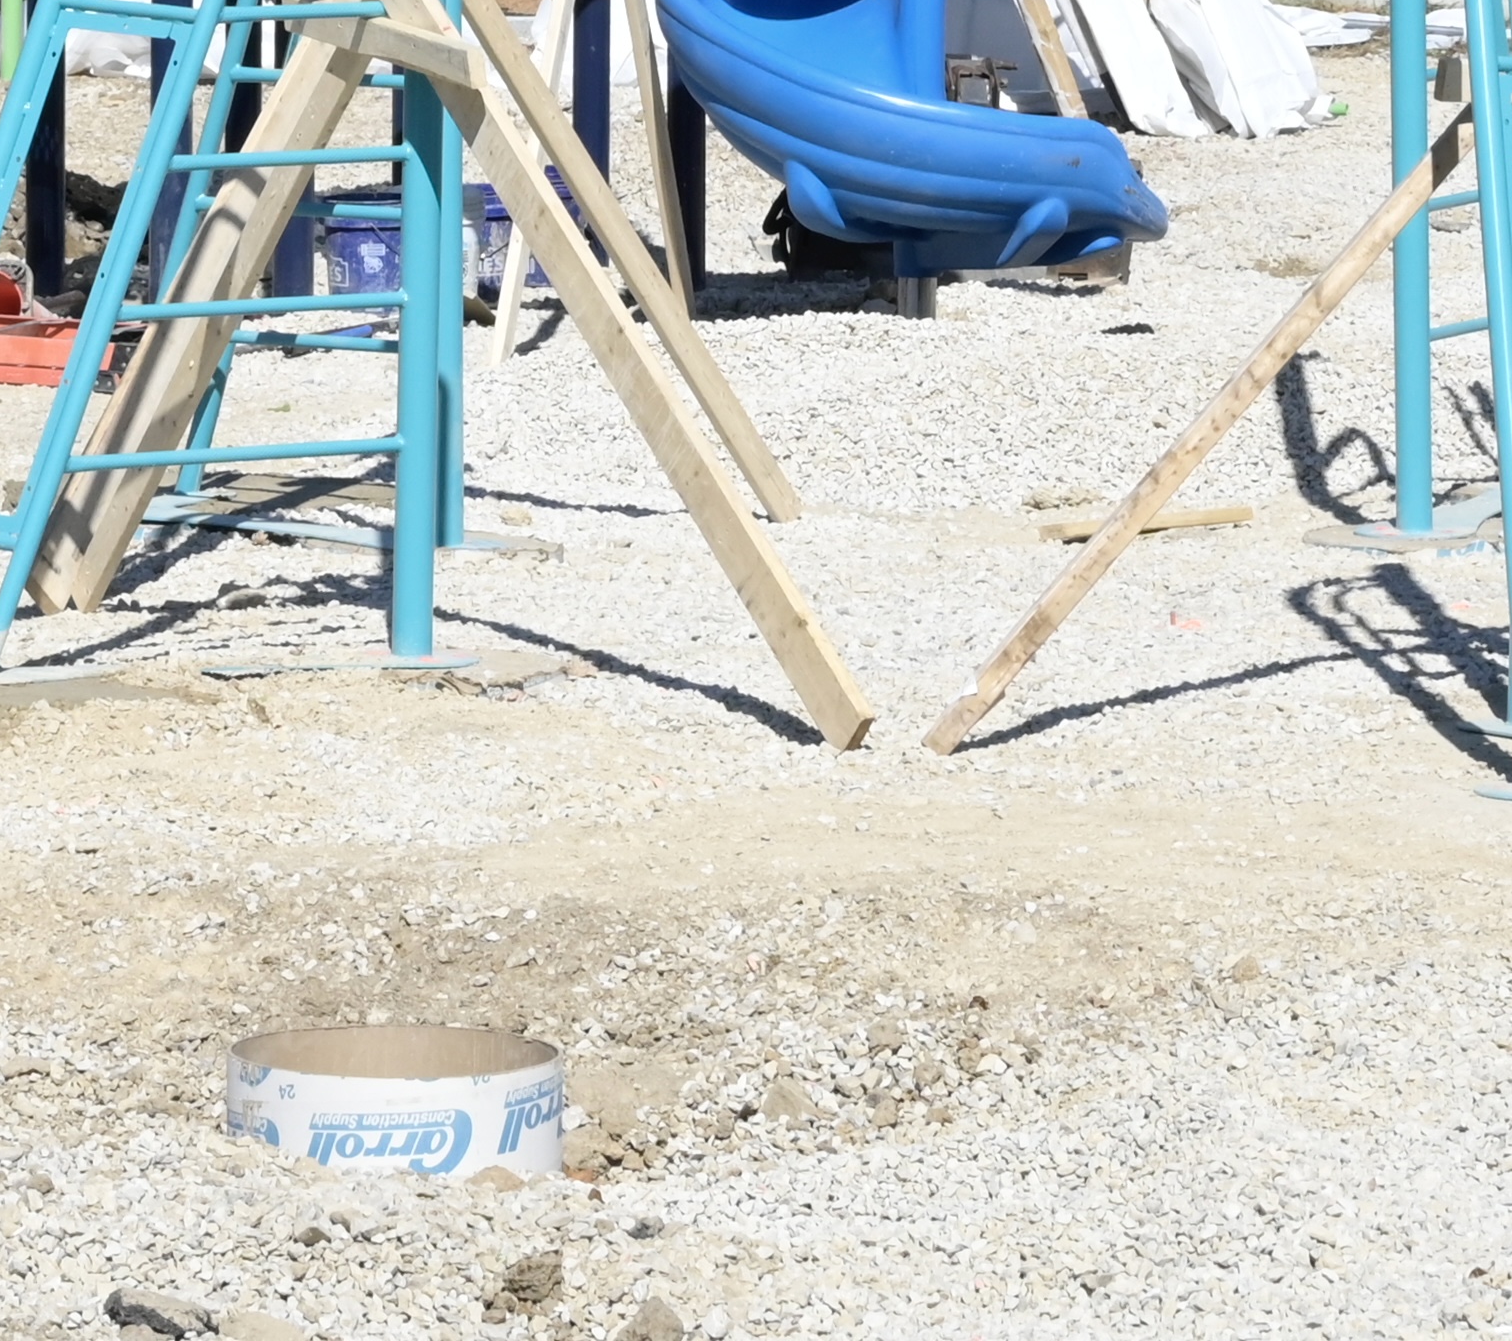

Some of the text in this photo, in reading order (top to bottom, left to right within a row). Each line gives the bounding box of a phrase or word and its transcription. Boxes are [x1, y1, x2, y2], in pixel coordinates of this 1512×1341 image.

[279, 1084, 296, 1100] 24
[311, 1109, 456, 1130] Construction Supply
[307, 1108, 473, 1176] Carroll
